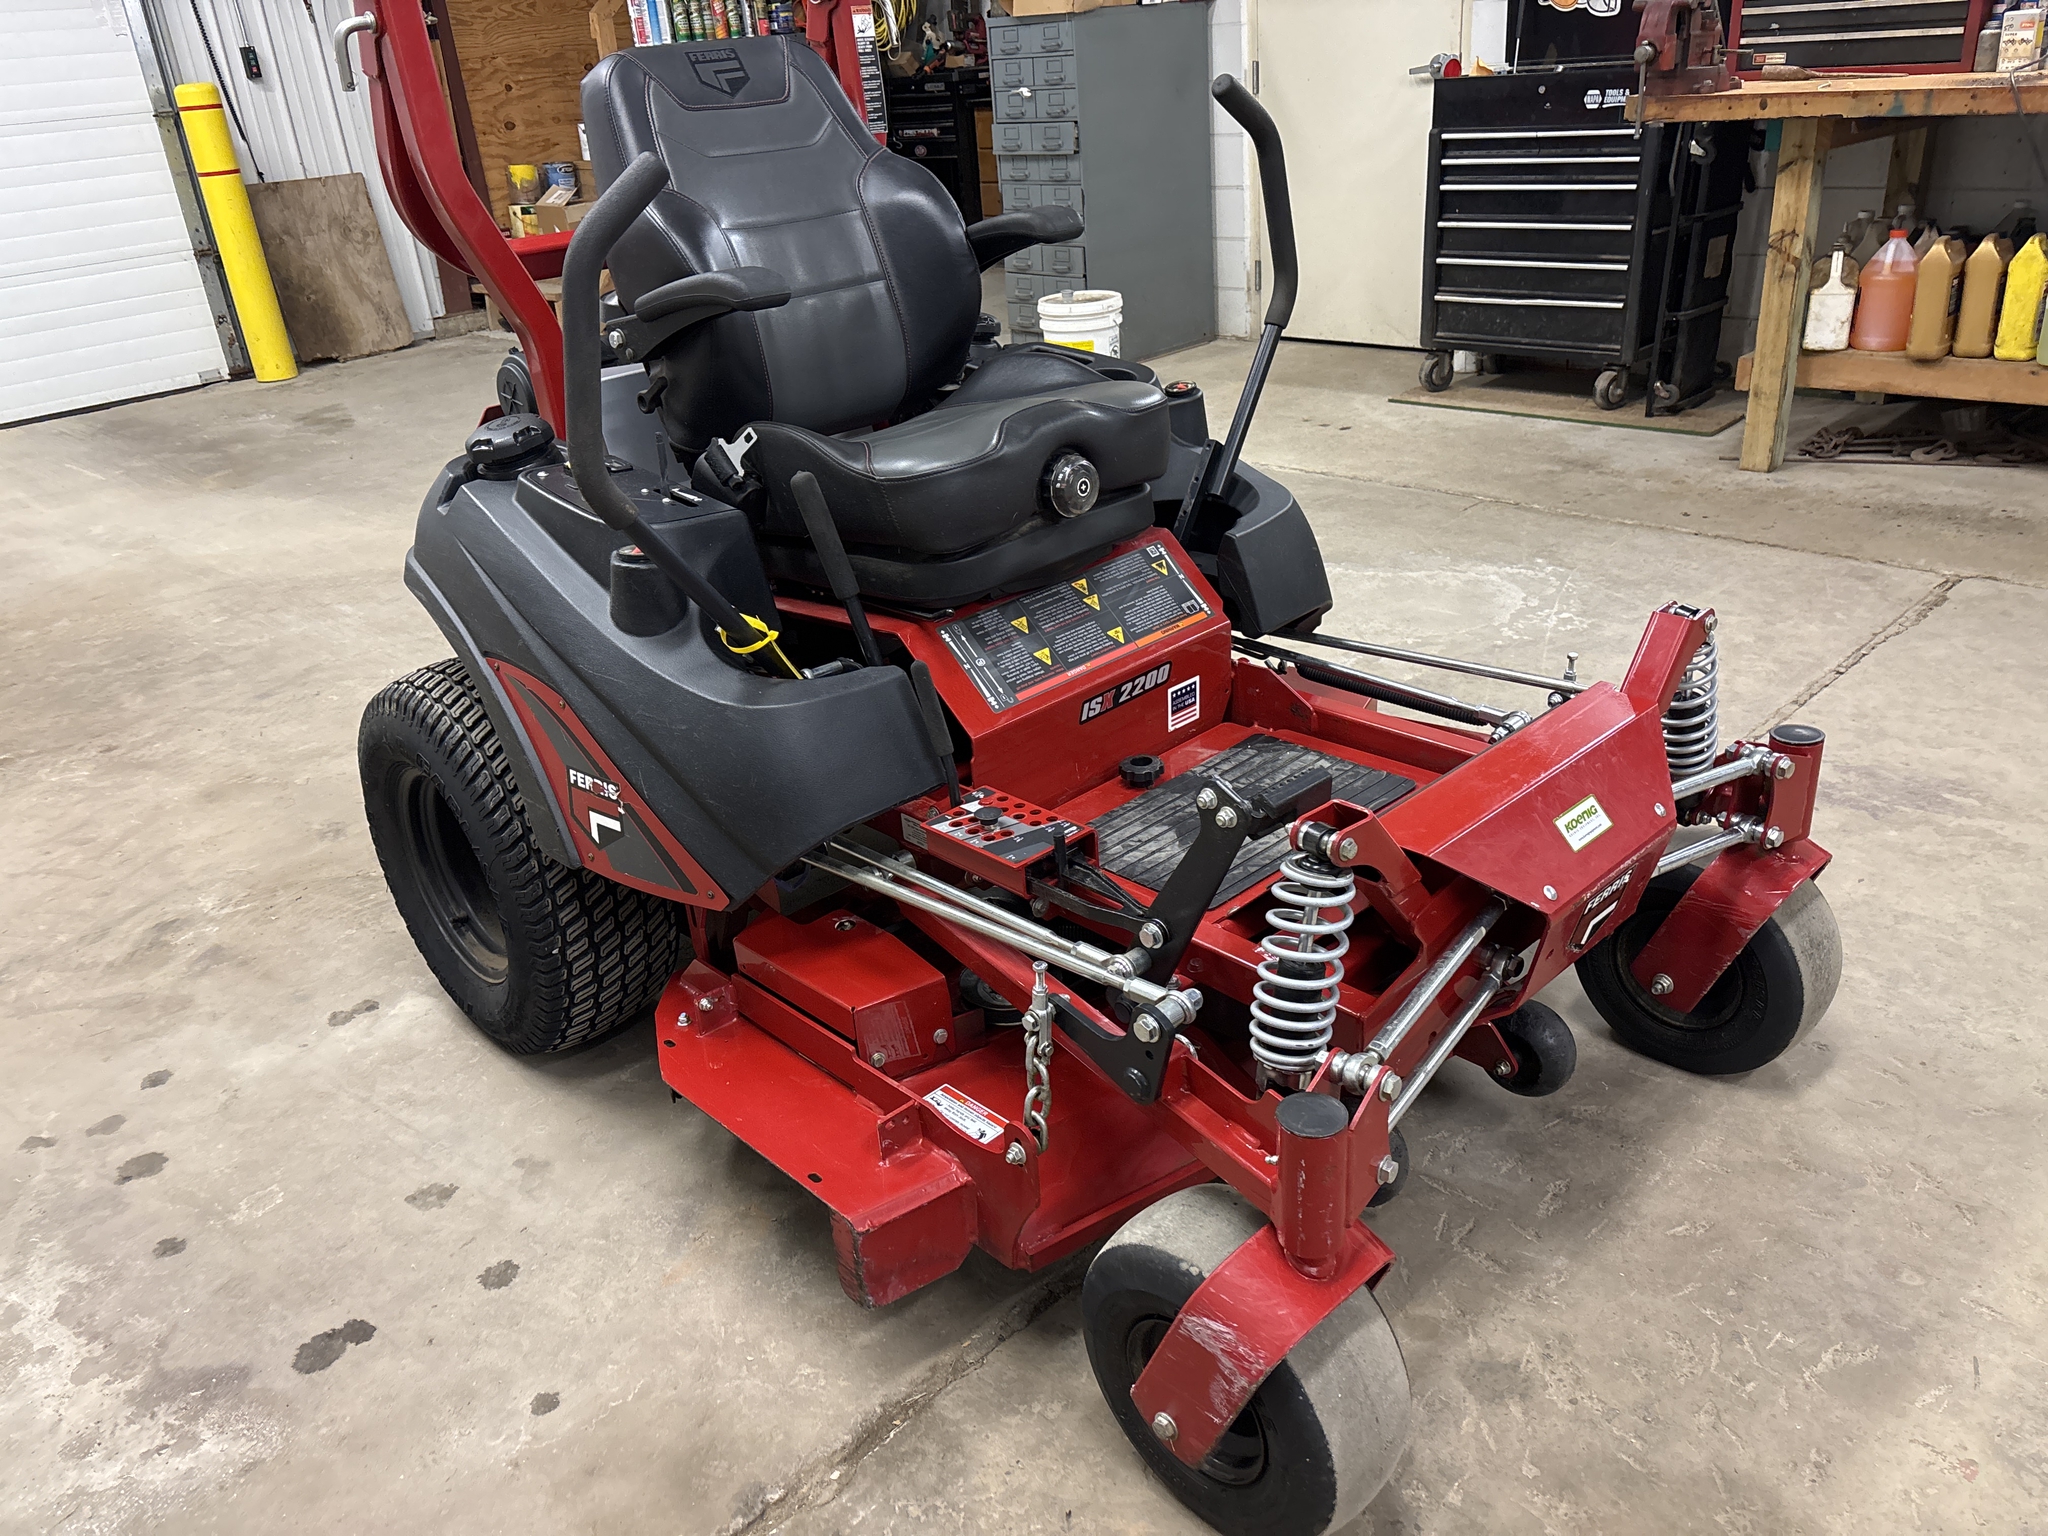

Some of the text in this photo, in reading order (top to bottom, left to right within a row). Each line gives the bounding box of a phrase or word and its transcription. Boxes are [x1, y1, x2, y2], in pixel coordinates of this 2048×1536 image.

[688, 50, 735, 61] FERRIS
[1586, 95, 1600, 104] NAPA
[1066, 664, 1087, 677] DANGER
[1081, 663, 1171, 721] ISX 2200
[1184, 696, 1196, 706] USA
[1584, 869, 1633, 915] FERRIS
[964, 1100, 989, 1117] DANGER
